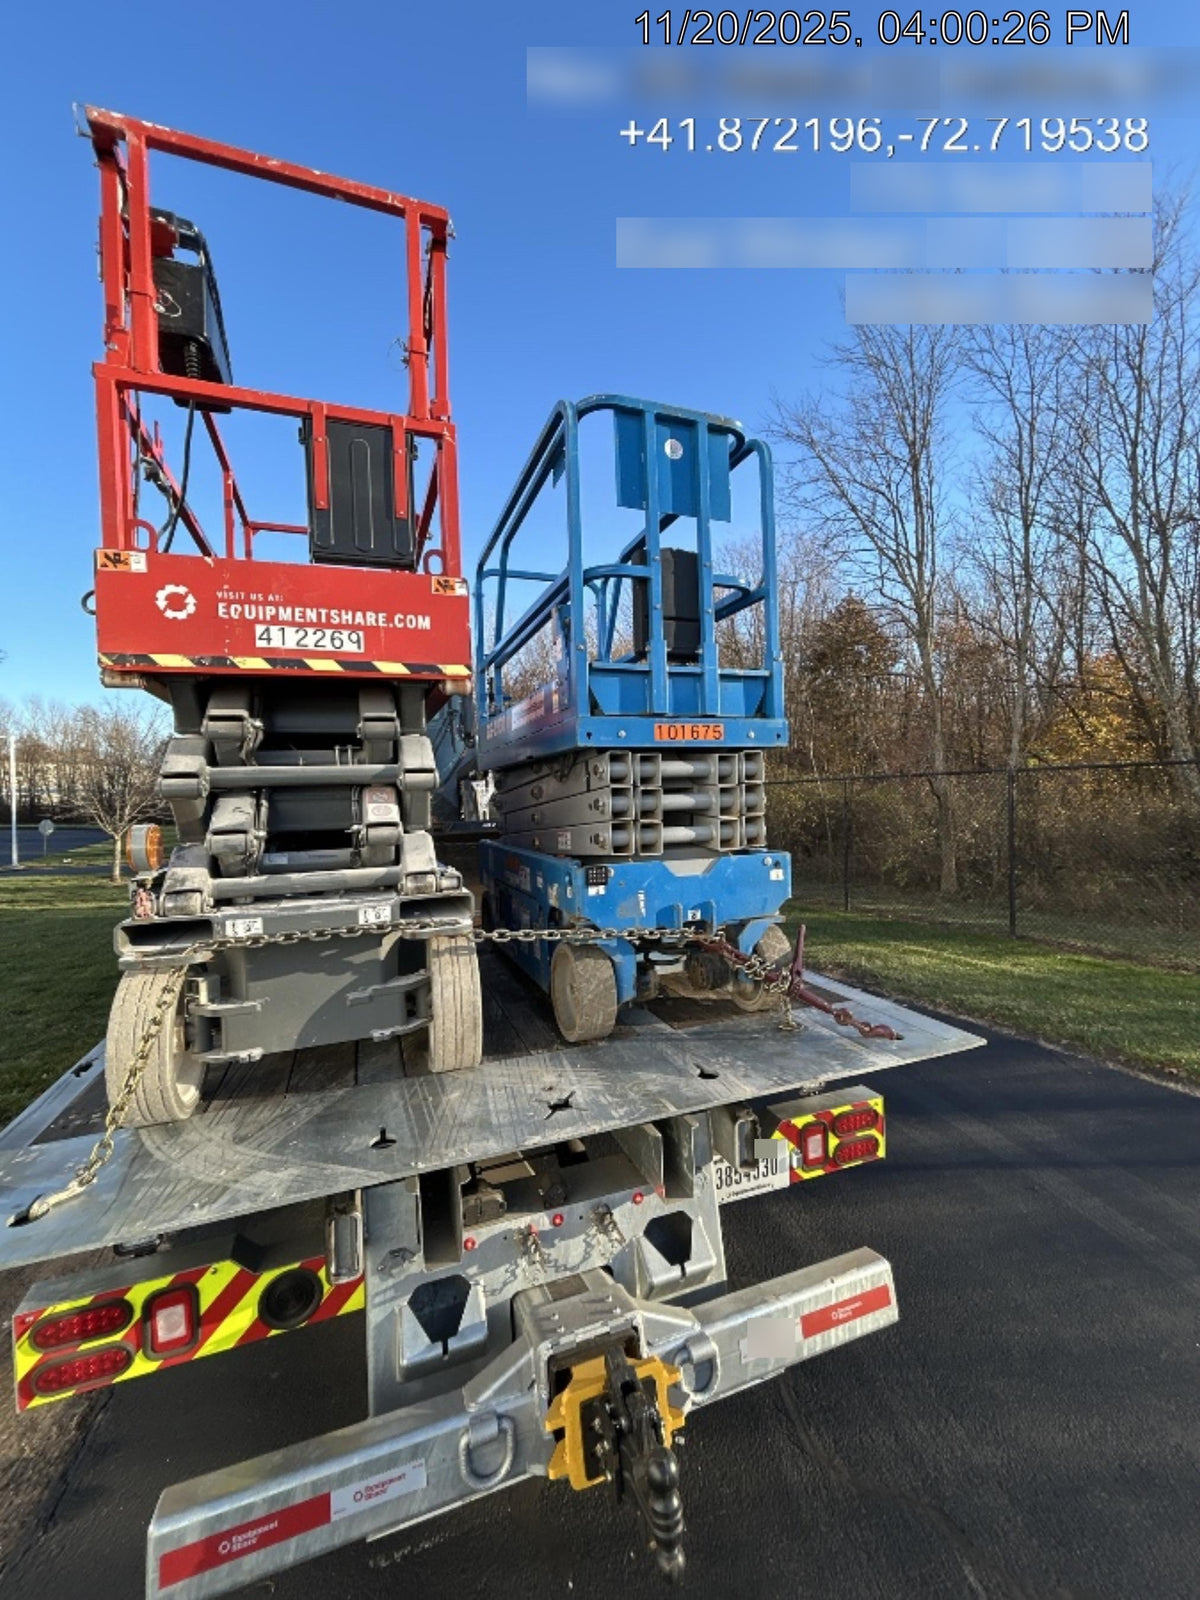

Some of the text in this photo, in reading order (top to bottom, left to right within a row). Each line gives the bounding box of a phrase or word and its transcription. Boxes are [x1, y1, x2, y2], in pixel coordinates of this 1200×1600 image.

[250, 593, 264, 601] US
[217, 602, 431, 630] EQUIPMENTSHARE.COM
[257, 626, 361, 651] 412269
[657, 724, 722, 740] 101675
